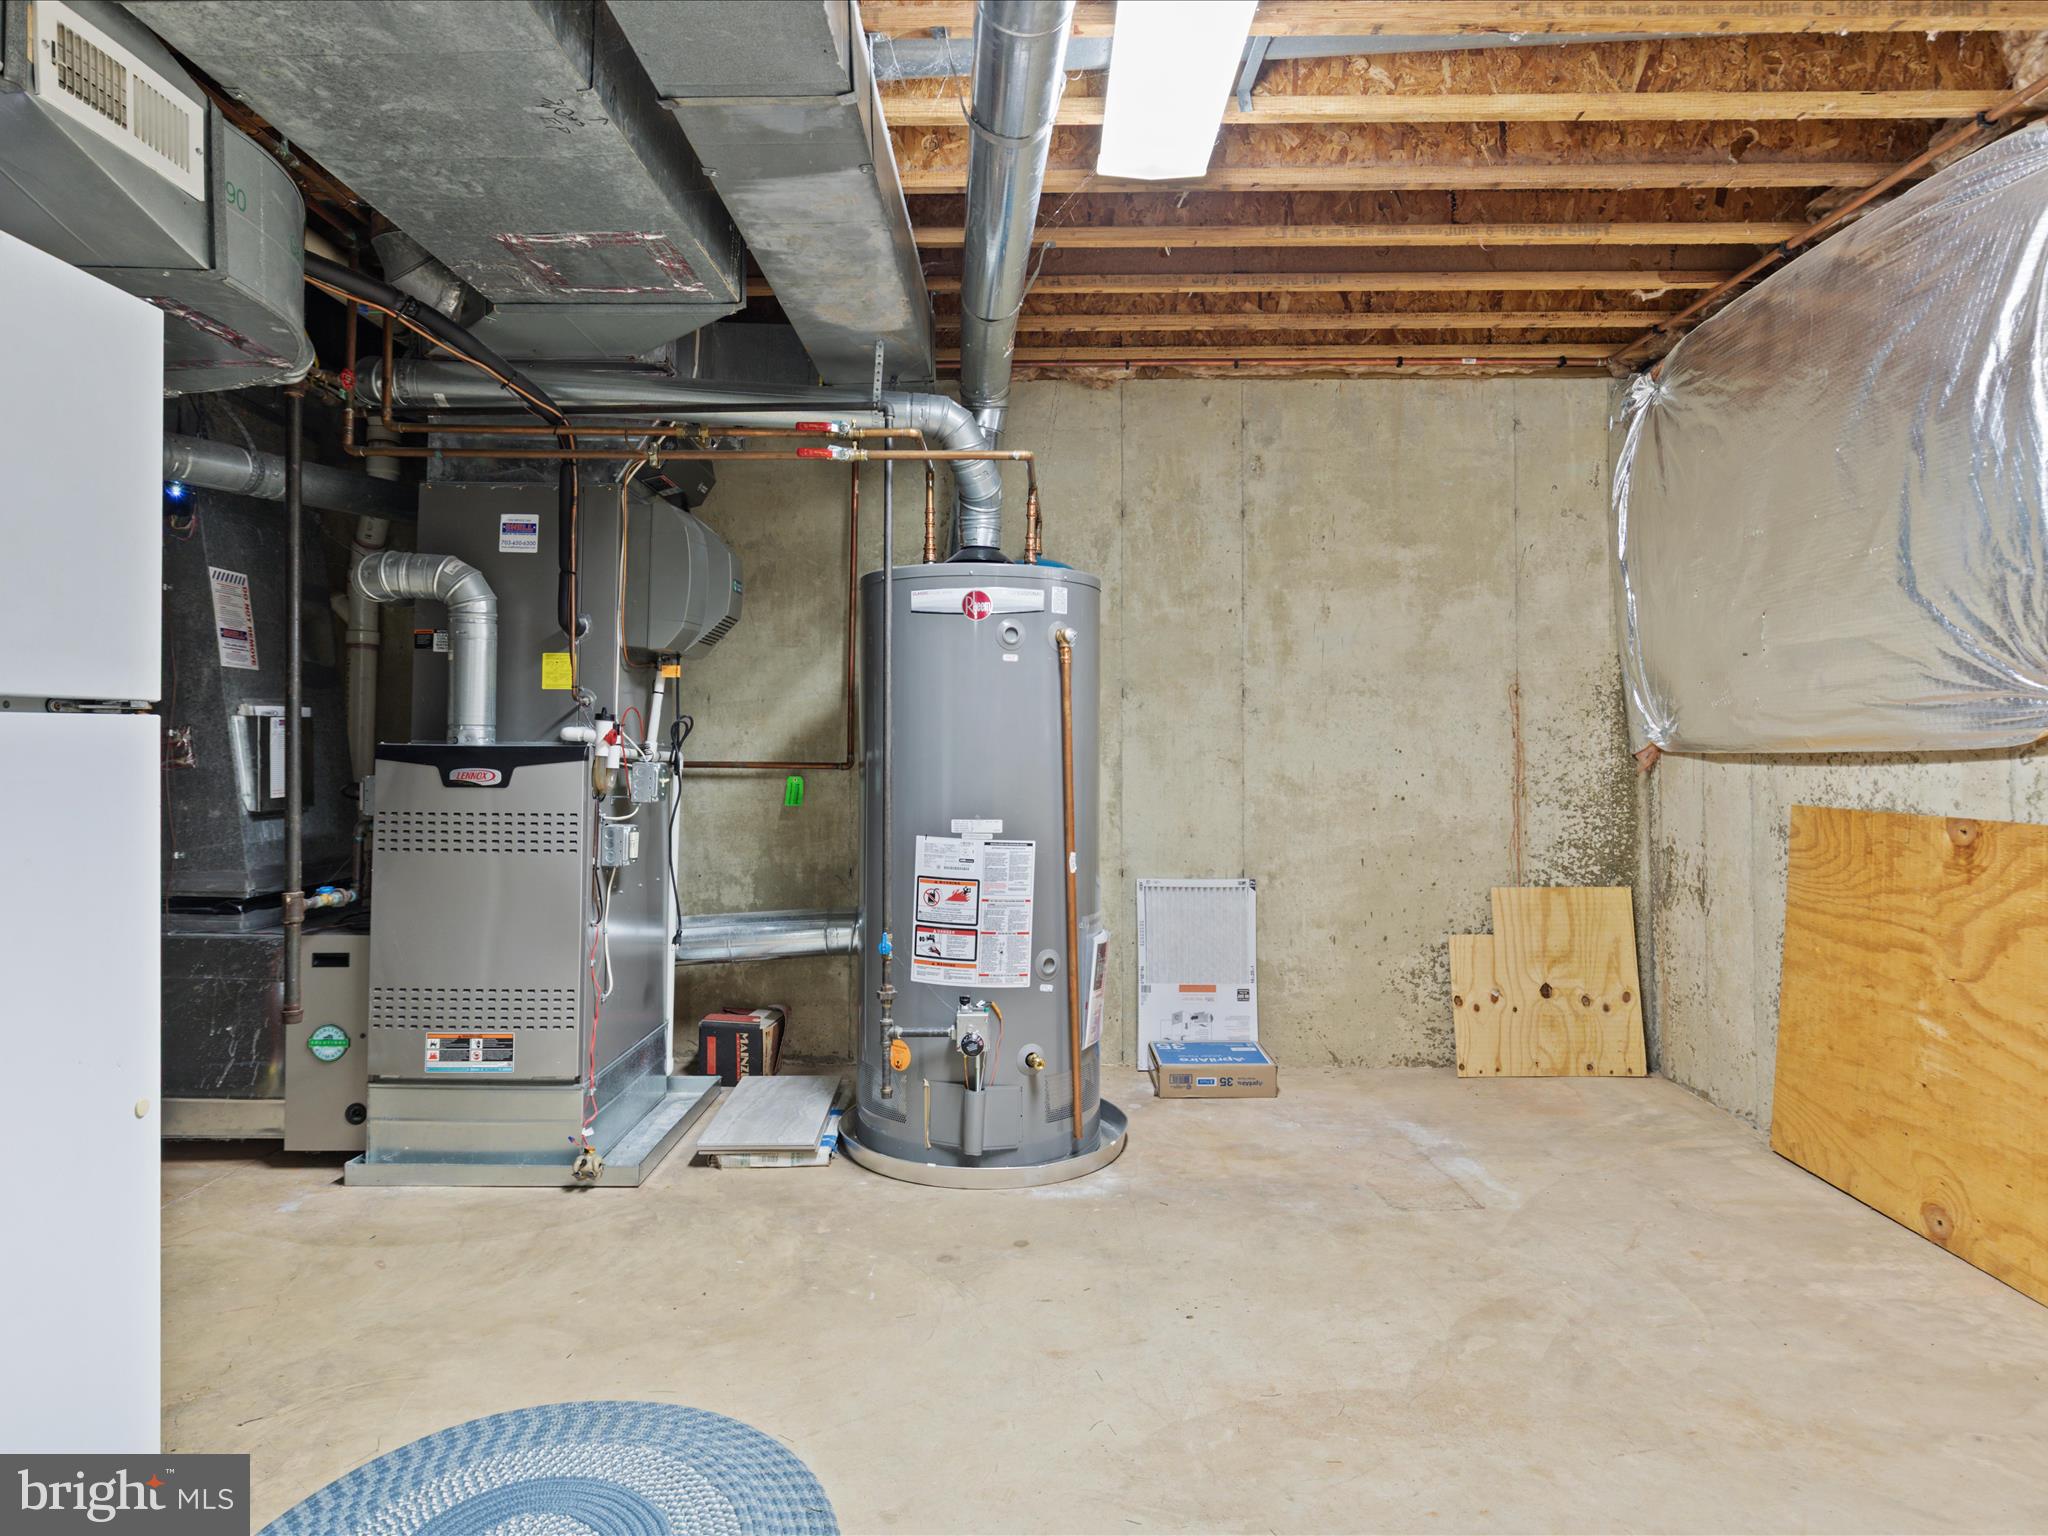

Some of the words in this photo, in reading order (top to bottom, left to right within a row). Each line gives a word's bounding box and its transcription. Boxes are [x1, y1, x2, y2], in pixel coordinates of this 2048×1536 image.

[1753, 0, 1801, 16] June
[1812, 1, 1824, 14] 6
[1838, 1, 1882, 16] 1992
[224, 180, 247, 212] 90
[1445, 224, 1479, 236] June
[1504, 224, 1535, 236] 1992
[1538, 224, 1563, 237] 3rd
[1567, 223, 1613, 236] SHIFT
[456, 771, 488, 780] LENNOX
[1219, 1076, 1234, 1087] 35
